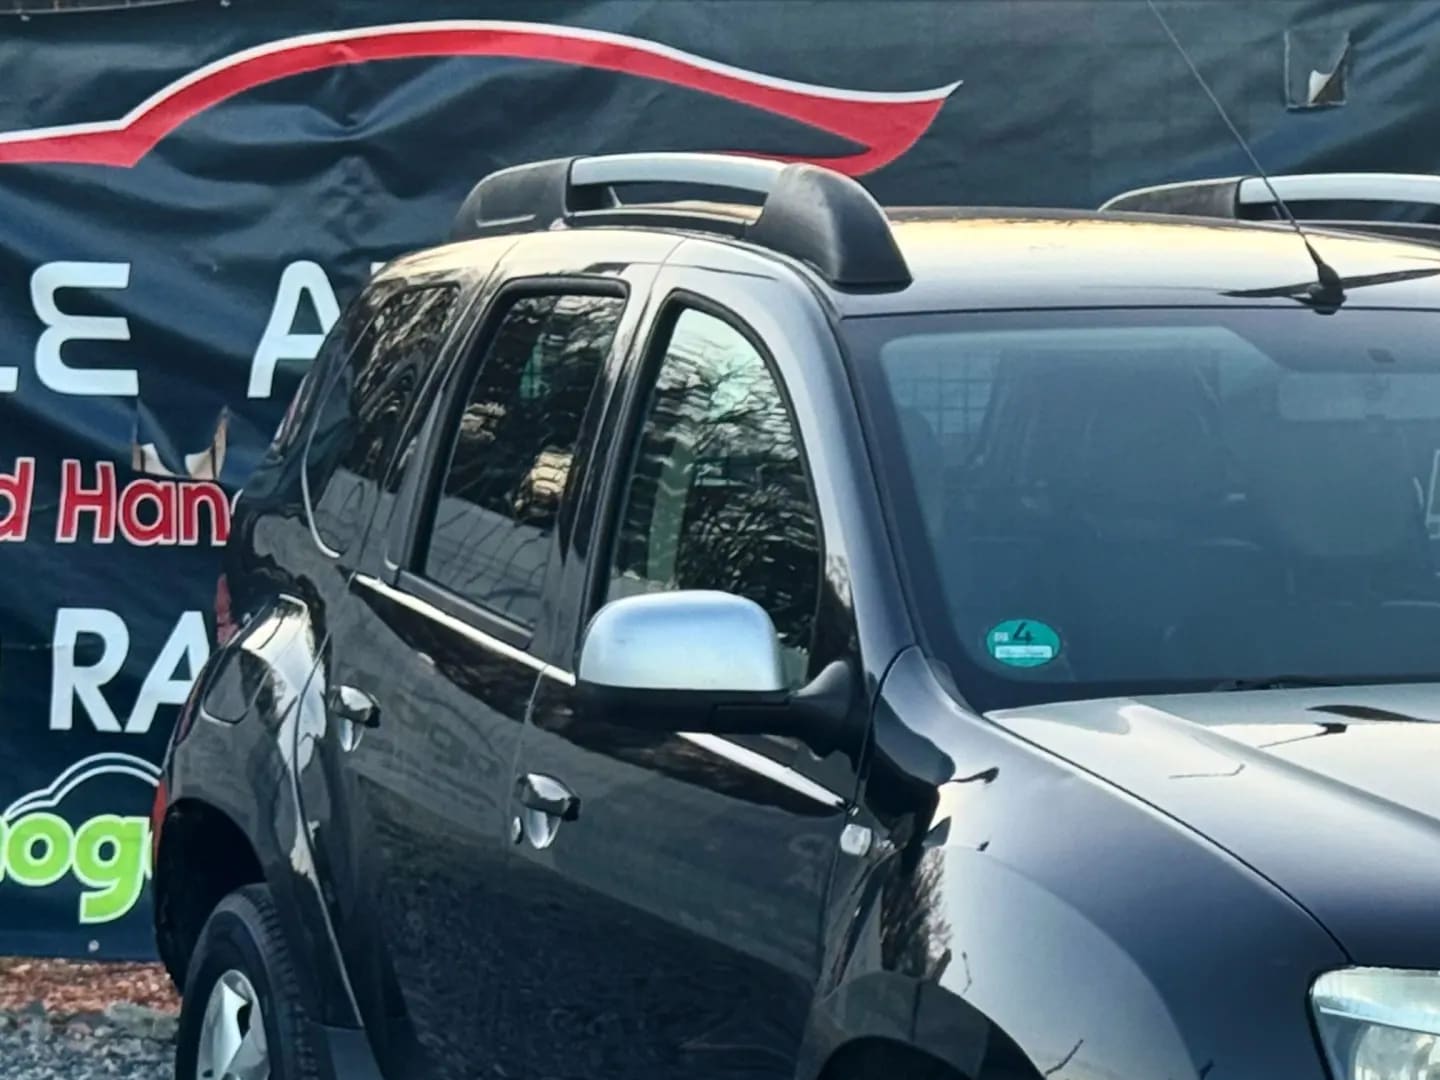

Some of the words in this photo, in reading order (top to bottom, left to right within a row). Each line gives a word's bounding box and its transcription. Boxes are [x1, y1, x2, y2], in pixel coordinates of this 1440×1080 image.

[0, 261, 139, 396] E
[248, 260, 386, 398] A
[55, 459, 243, 546] Han
[50, 608, 210, 734] RA
[0, 812, 153, 924] og
